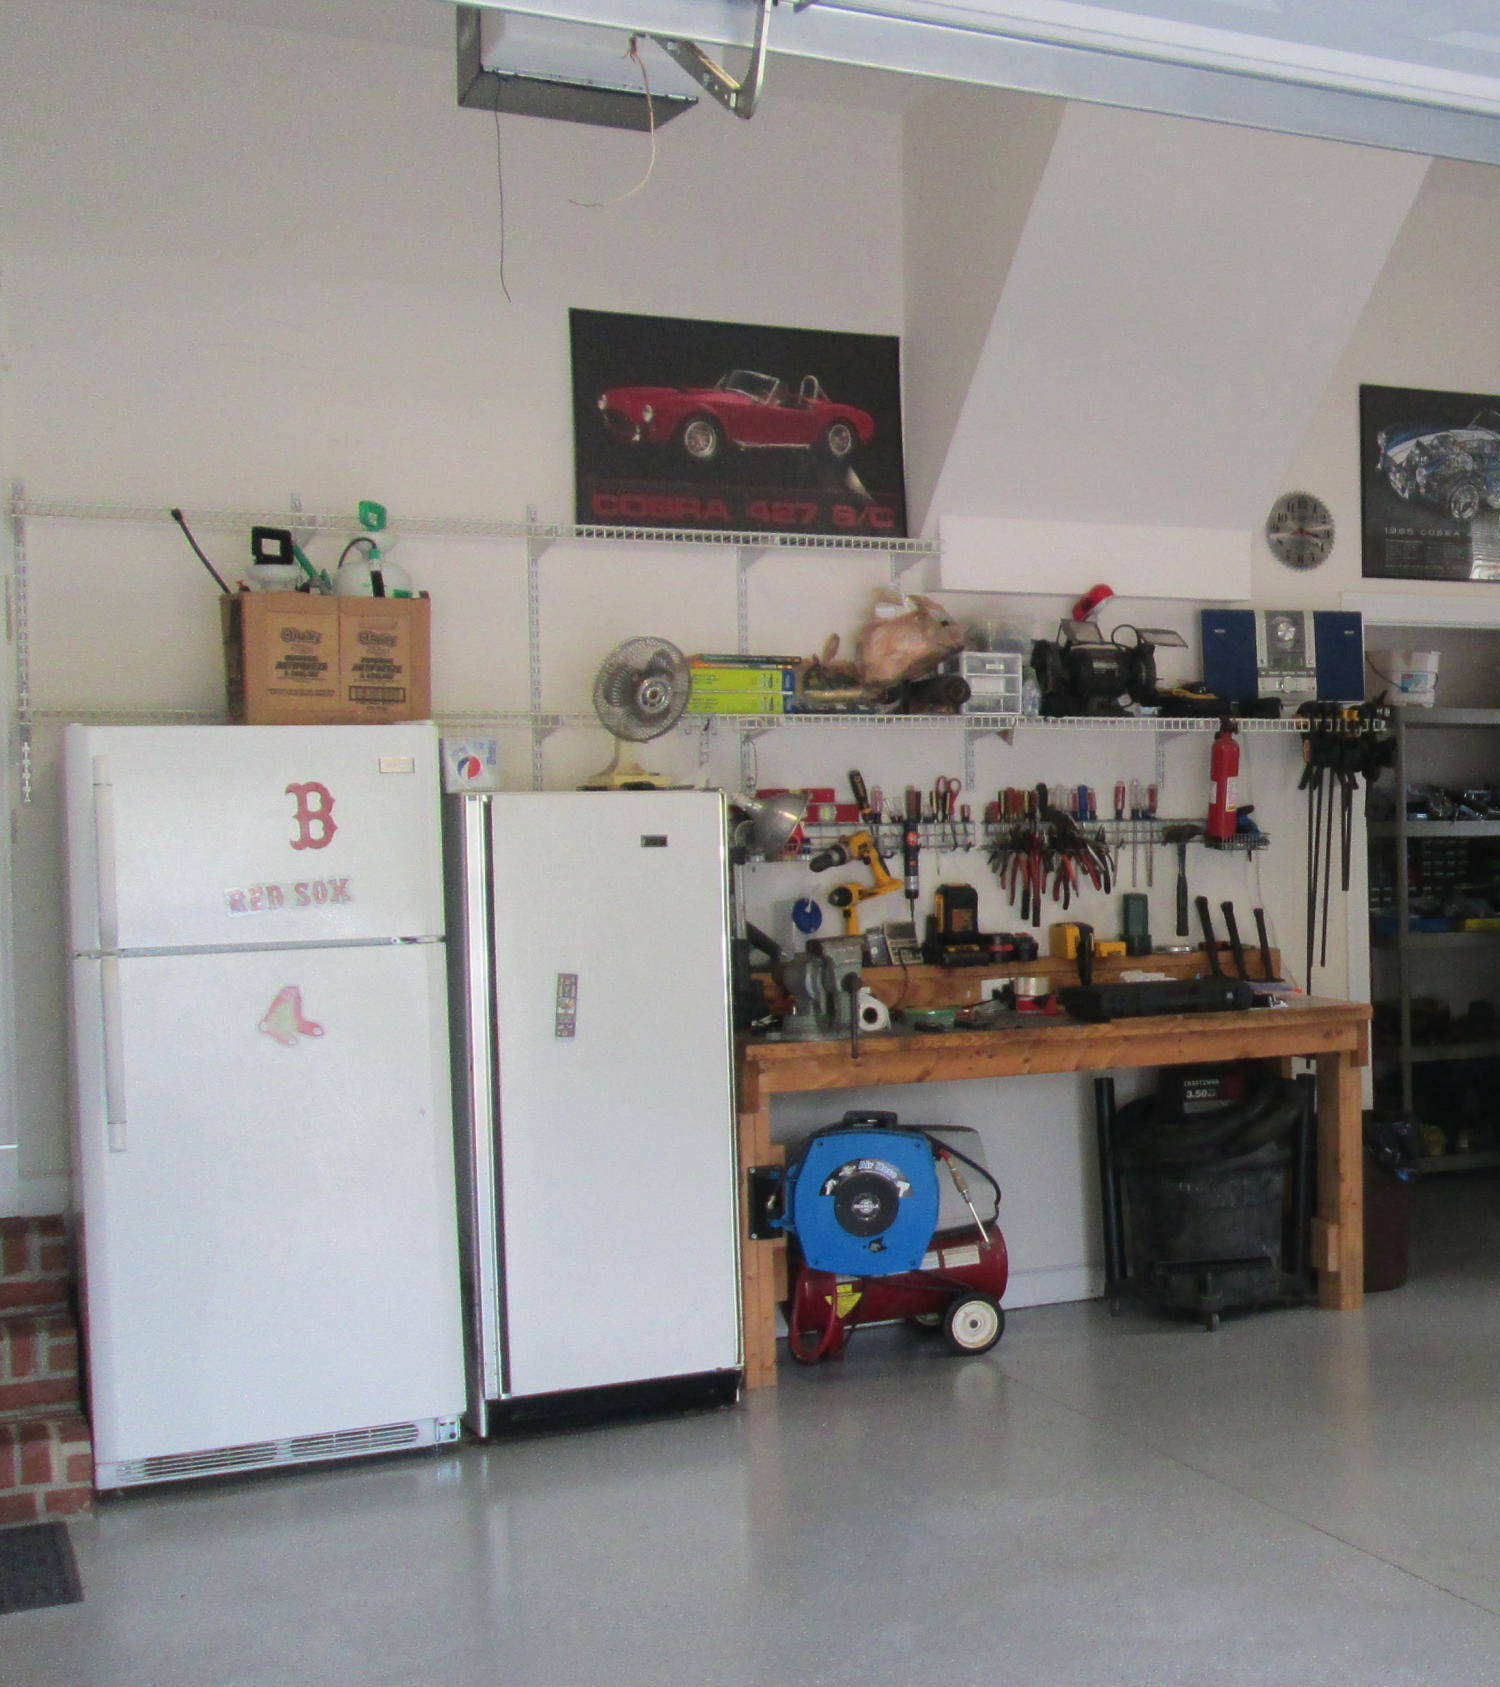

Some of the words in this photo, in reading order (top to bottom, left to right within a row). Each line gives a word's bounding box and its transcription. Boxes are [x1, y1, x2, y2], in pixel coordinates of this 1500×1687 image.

[592, 493, 731, 521] COBRA
[745, 498, 819, 524] 427
[831, 504, 895, 529] S/C
[1419, 528, 1461, 537] COBRA
[284, 781, 338, 850] B
[228, 884, 285, 912] RED
[294, 878, 352, 907] SOX
[1186, 1089, 1208, 1098] 3.50
[858, 1160, 874, 1171] Air
